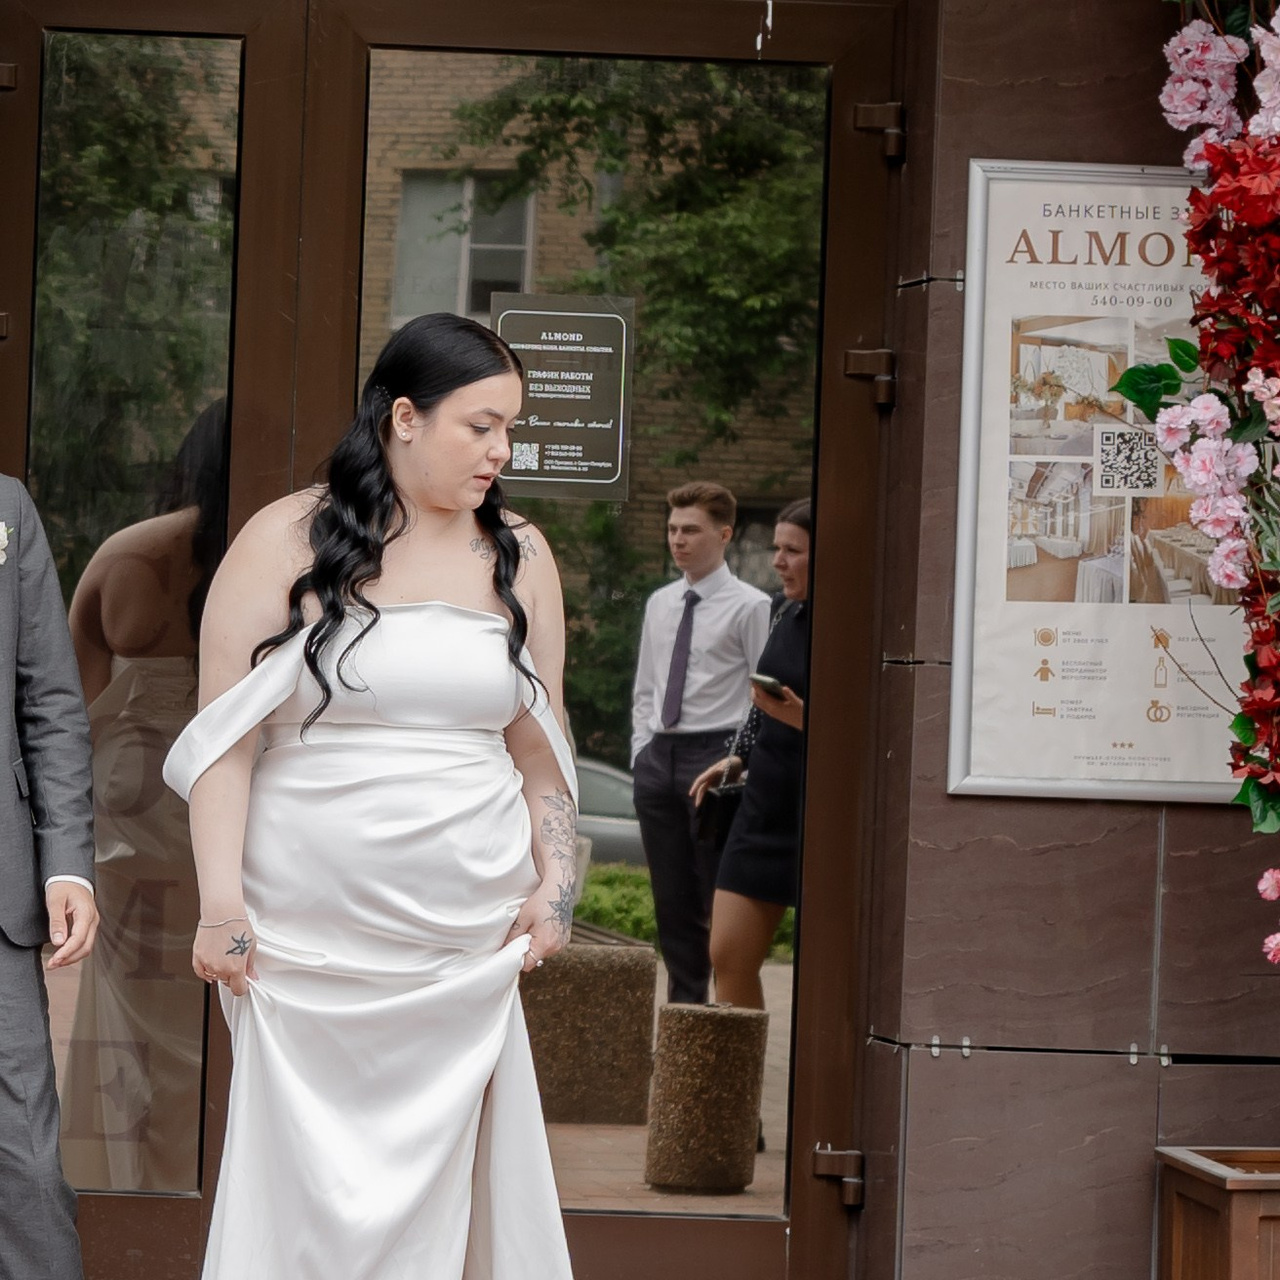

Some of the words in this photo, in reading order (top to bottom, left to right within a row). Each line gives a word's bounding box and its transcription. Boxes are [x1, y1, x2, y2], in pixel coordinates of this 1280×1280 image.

[1042, 203, 1162, 220] БАНКЕТНЫЕ
[1029, 281, 1066, 290] МЕСТО
[1070, 282, 1109, 291] ВАШИХ
[1113, 283, 1185, 293] СЧАСТЛИВЫХ
[1090, 295, 1173, 308] 540-09-00
[540, 331, 583, 341] ALMOND
[527, 370, 560, 379] ГРАФИК
[560, 371, 594, 381] РАБОТЫ
[528, 383, 544, 391] БЕЗ
[544, 384, 591, 394] ВЫХОДНЫХ
